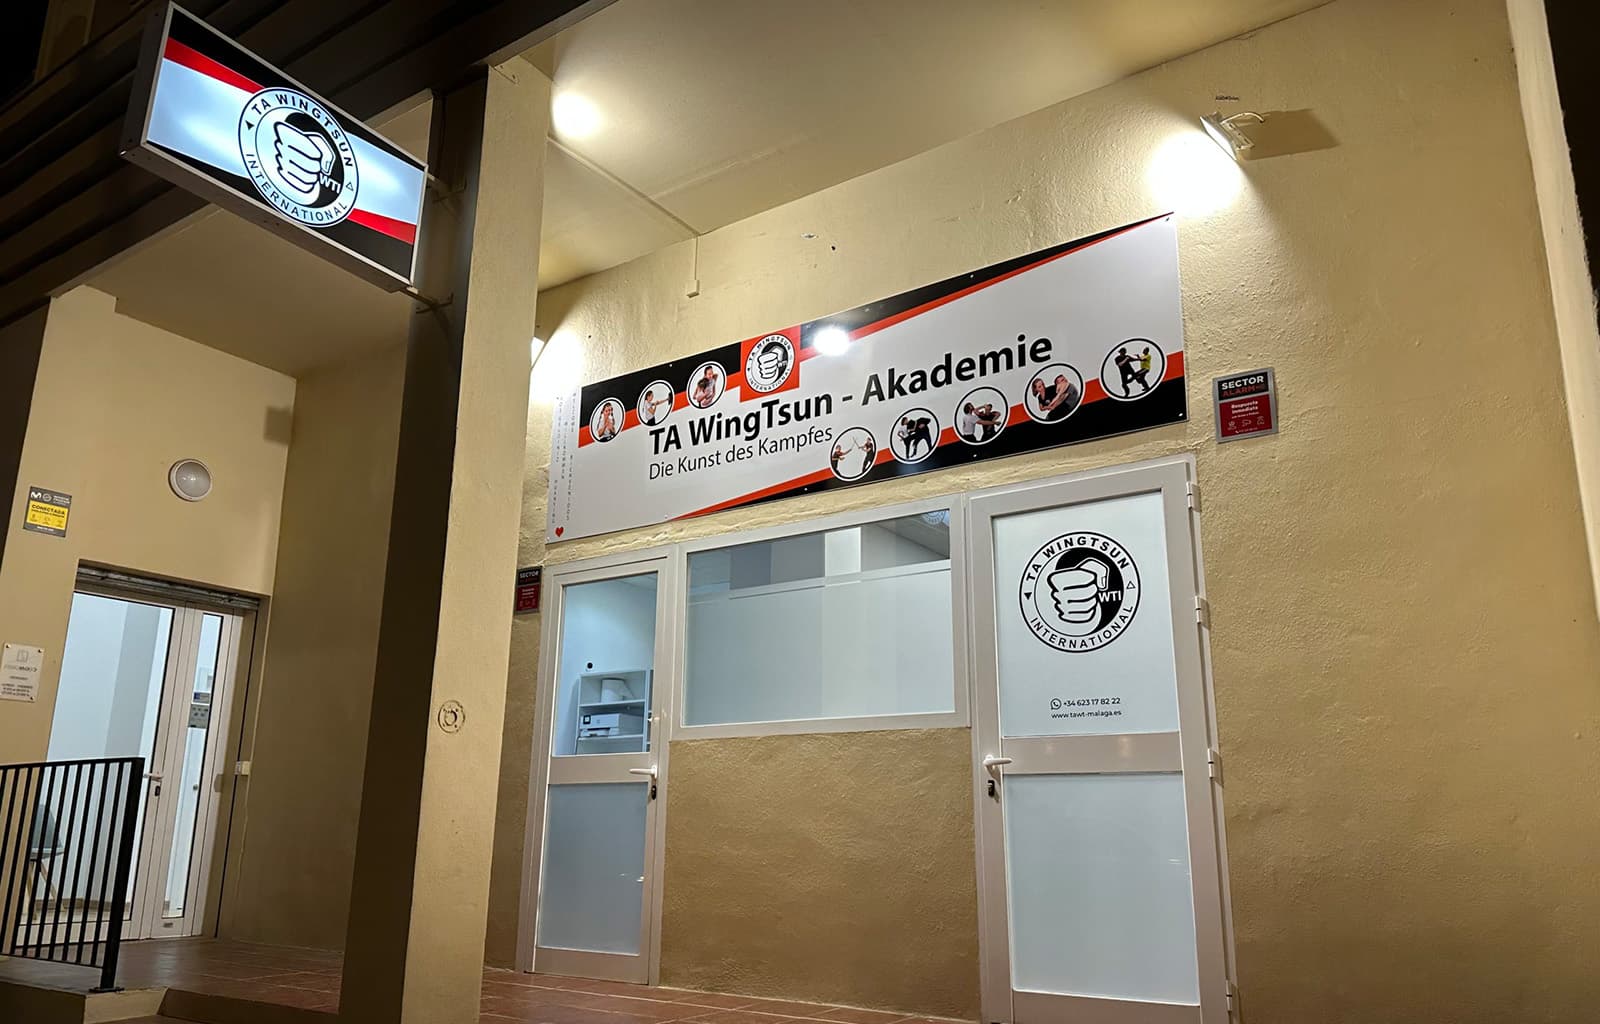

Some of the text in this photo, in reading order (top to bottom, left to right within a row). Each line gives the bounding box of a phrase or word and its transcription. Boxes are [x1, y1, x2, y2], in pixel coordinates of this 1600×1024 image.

[251, 93, 353, 167] TA WINGTSUN
[245, 153, 348, 222] INTERNATIONAL
[319, 173, 341, 194] WTI
[649, 424, 682, 456] TA
[688, 392, 832, 442] WingTsun
[861, 334, 1053, 406] Akademie
[1222, 375, 1264, 390] SECTOR
[649, 425, 833, 480] Die Kunst des Kampfes
[1025, 536, 1130, 581] TA WINGTSUN
[1098, 590, 1122, 603] WTI
[1030, 605, 1134, 649] INTERNATIONAL
[1051, 710, 1122, 719] www.tawt-malaga.es
